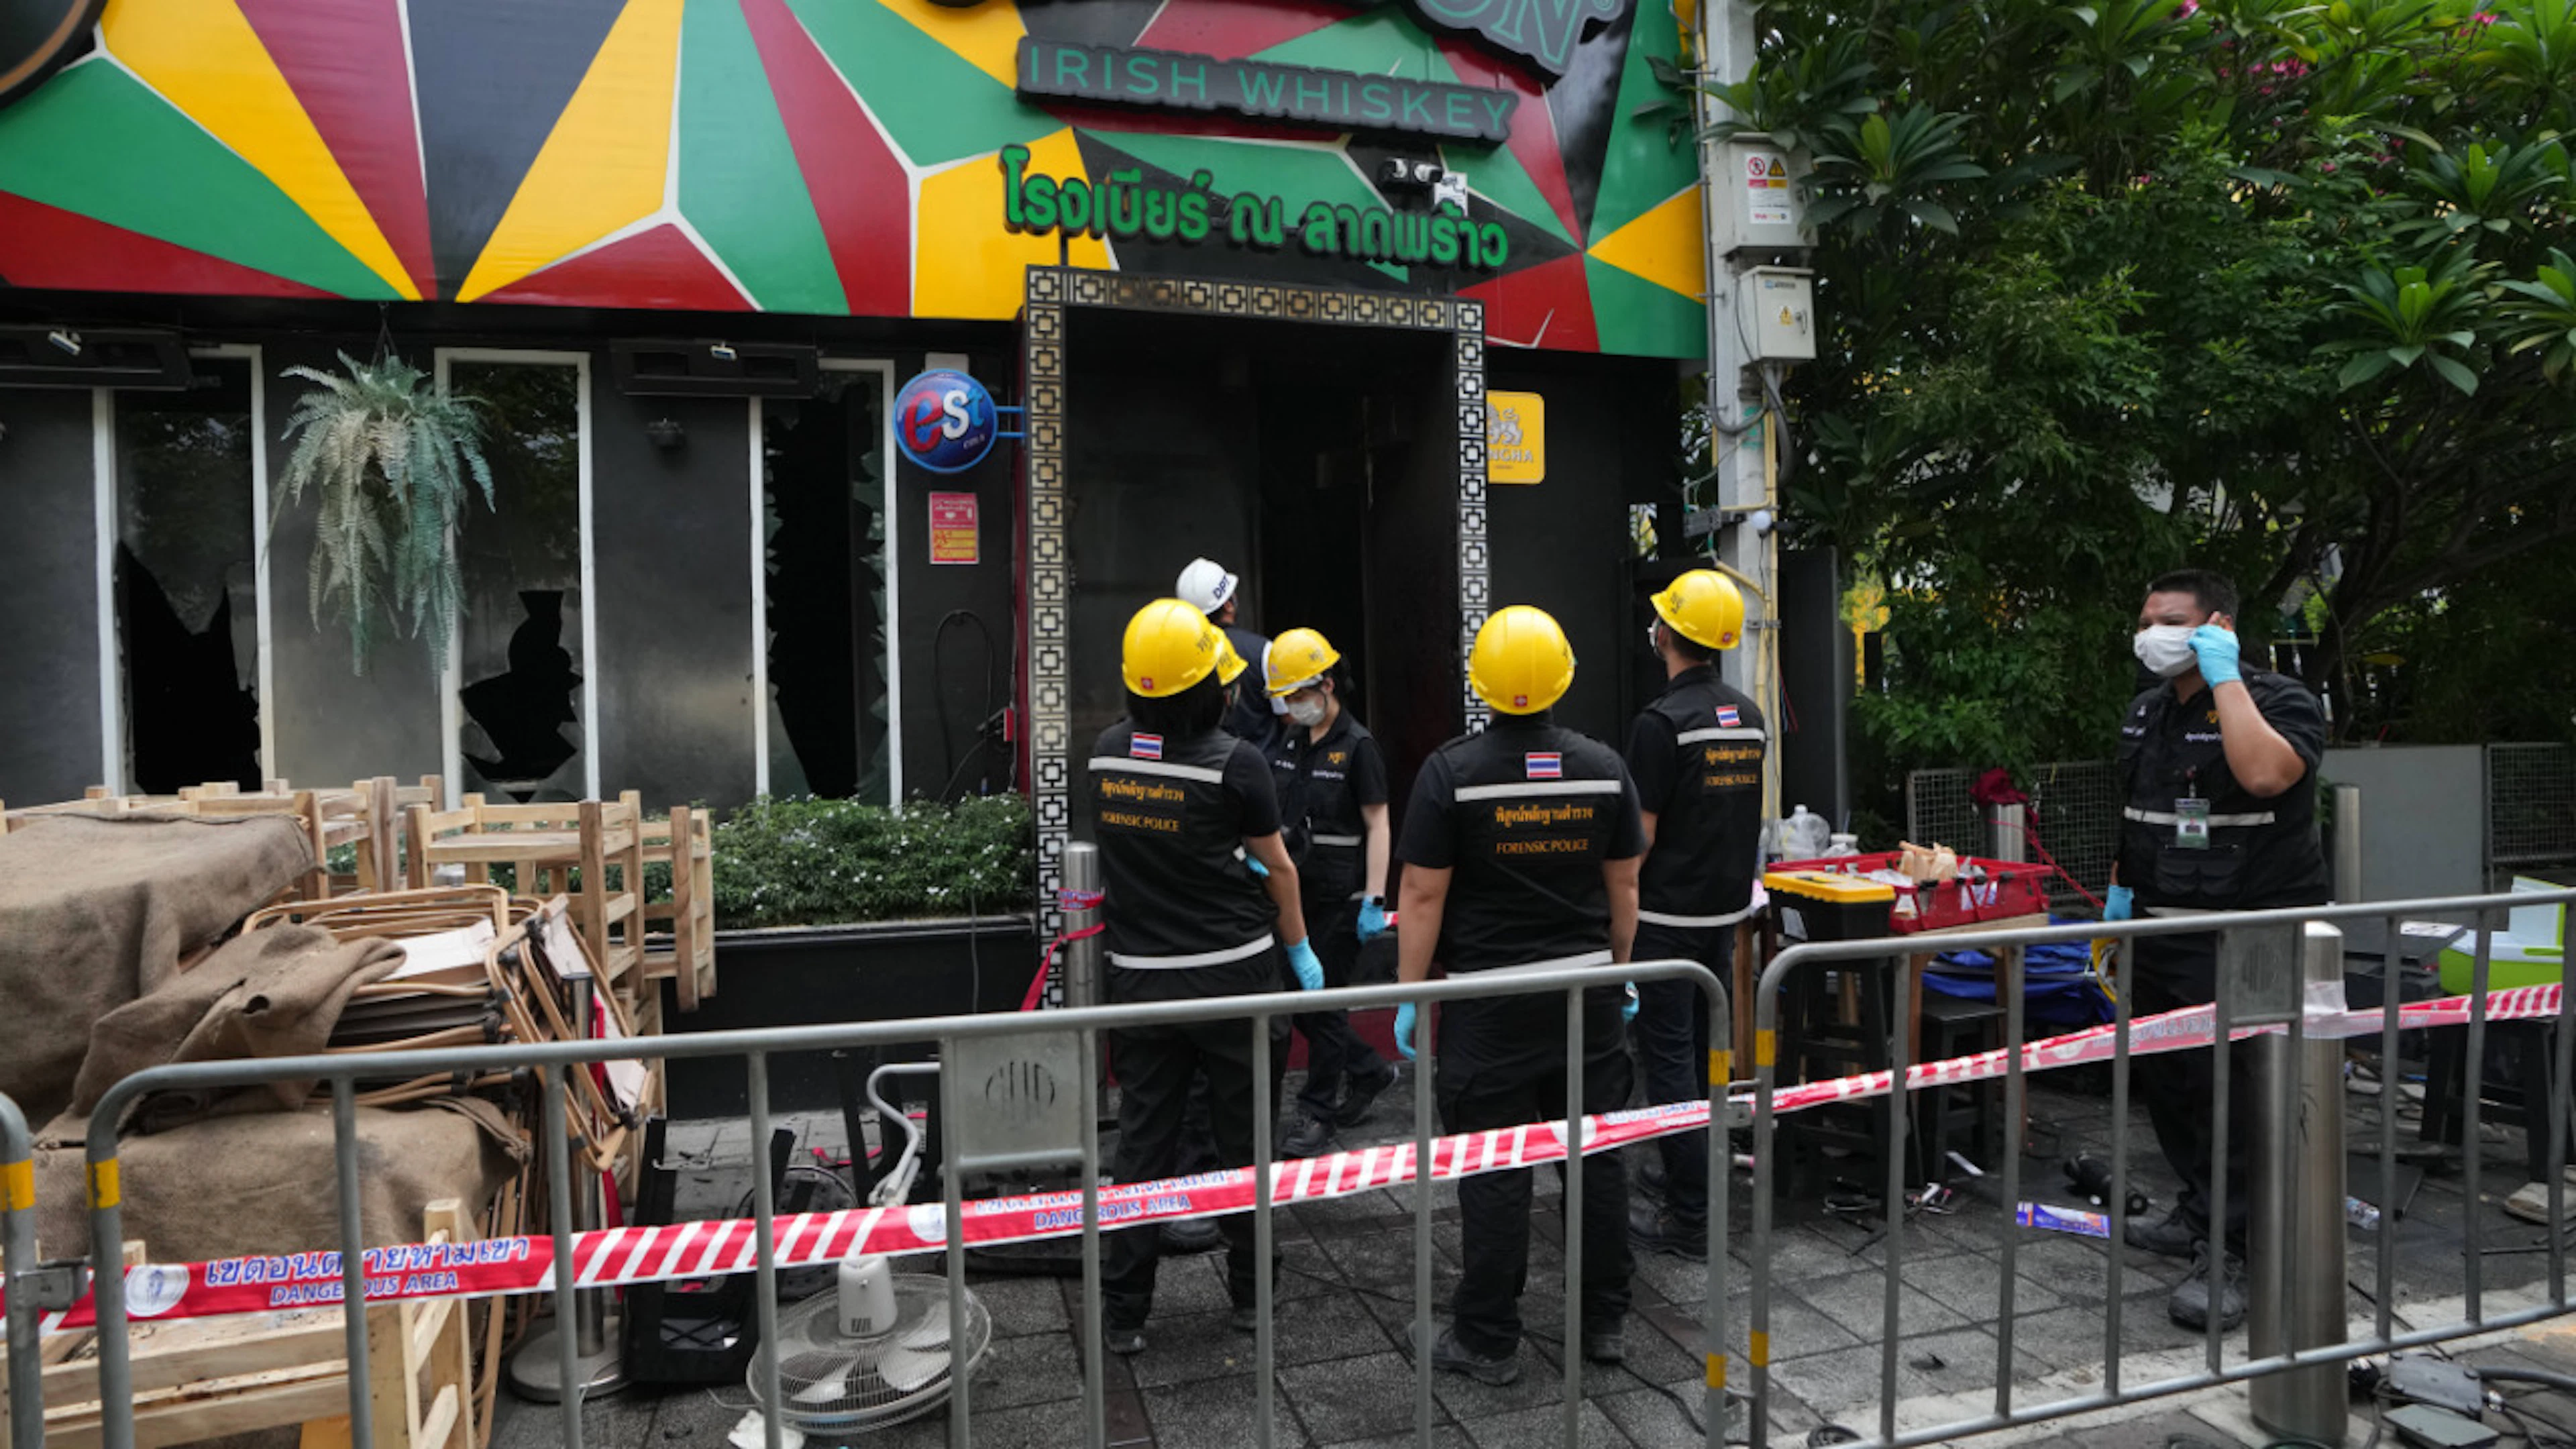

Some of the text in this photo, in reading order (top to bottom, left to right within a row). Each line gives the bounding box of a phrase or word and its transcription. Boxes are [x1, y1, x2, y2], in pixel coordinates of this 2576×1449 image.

[1030, 48, 1509, 131] IRISH WHISKEY
[1002, 146, 1510, 268] โรงเบียร์ ณ ลาดพร้าว
[905, 386, 983, 452] est
[1487, 447, 1534, 463] NGHA
[1213, 575, 1230, 600] DPT
[1143, 816, 1180, 832] POLICE
[1496, 839, 1589, 854] FORENSIC POLICE
[1034, 1200, 1142, 1230] DANGROUS
[270, 1271, 458, 1305] DANGEOUS AREA
